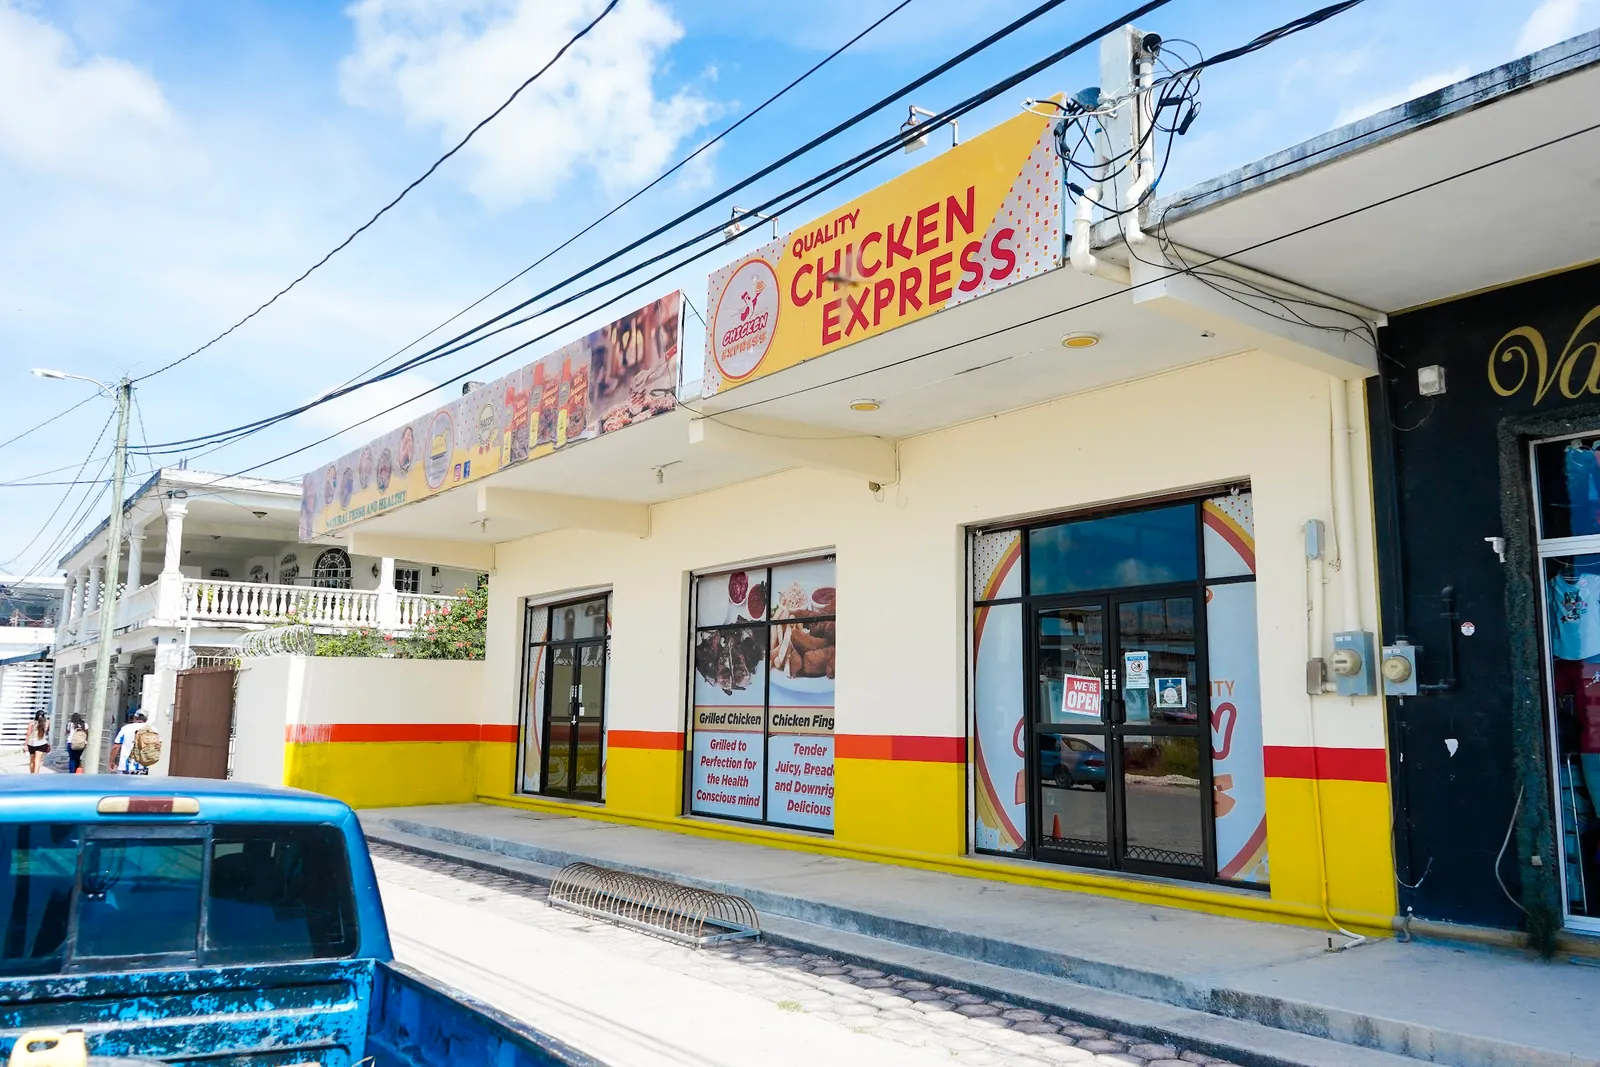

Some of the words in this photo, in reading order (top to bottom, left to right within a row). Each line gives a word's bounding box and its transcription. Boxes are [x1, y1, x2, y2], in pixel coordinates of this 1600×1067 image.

[792, 209, 861, 258] QUALITY
[790, 185, 976, 307] CHICKEN
[821, 227, 1016, 347] EXPRESS
[722, 312, 769, 347] CHICKEN
[721, 330, 767, 361] EXPRESS
[366, 500, 378, 515] AND
[1073, 680, 1097, 692] WE'RE
[1067, 690, 1099, 711] OPEN
[699, 712, 726, 724] Grilled
[727, 713, 761, 725] Chicken
[772, 714, 811, 727] Chicken
[812, 715, 835, 730] Fing
[710, 739, 736, 751] Grilled
[738, 740, 747, 751] to
[793, 743, 828, 756] Tender
[700, 756, 742, 769] Perfection
[743, 758, 757, 770] for
[775, 761, 801, 776] Juicy,
[803, 763, 835, 777] Bread
[707, 773, 720, 784] the
[721, 775, 749, 787] Health
[774, 780, 793, 792] and
[794, 781, 835, 798] Downrig
[696, 789, 737, 804] Conscious
[737, 794, 761, 807] mind
[786, 800, 832, 816] Delicious
